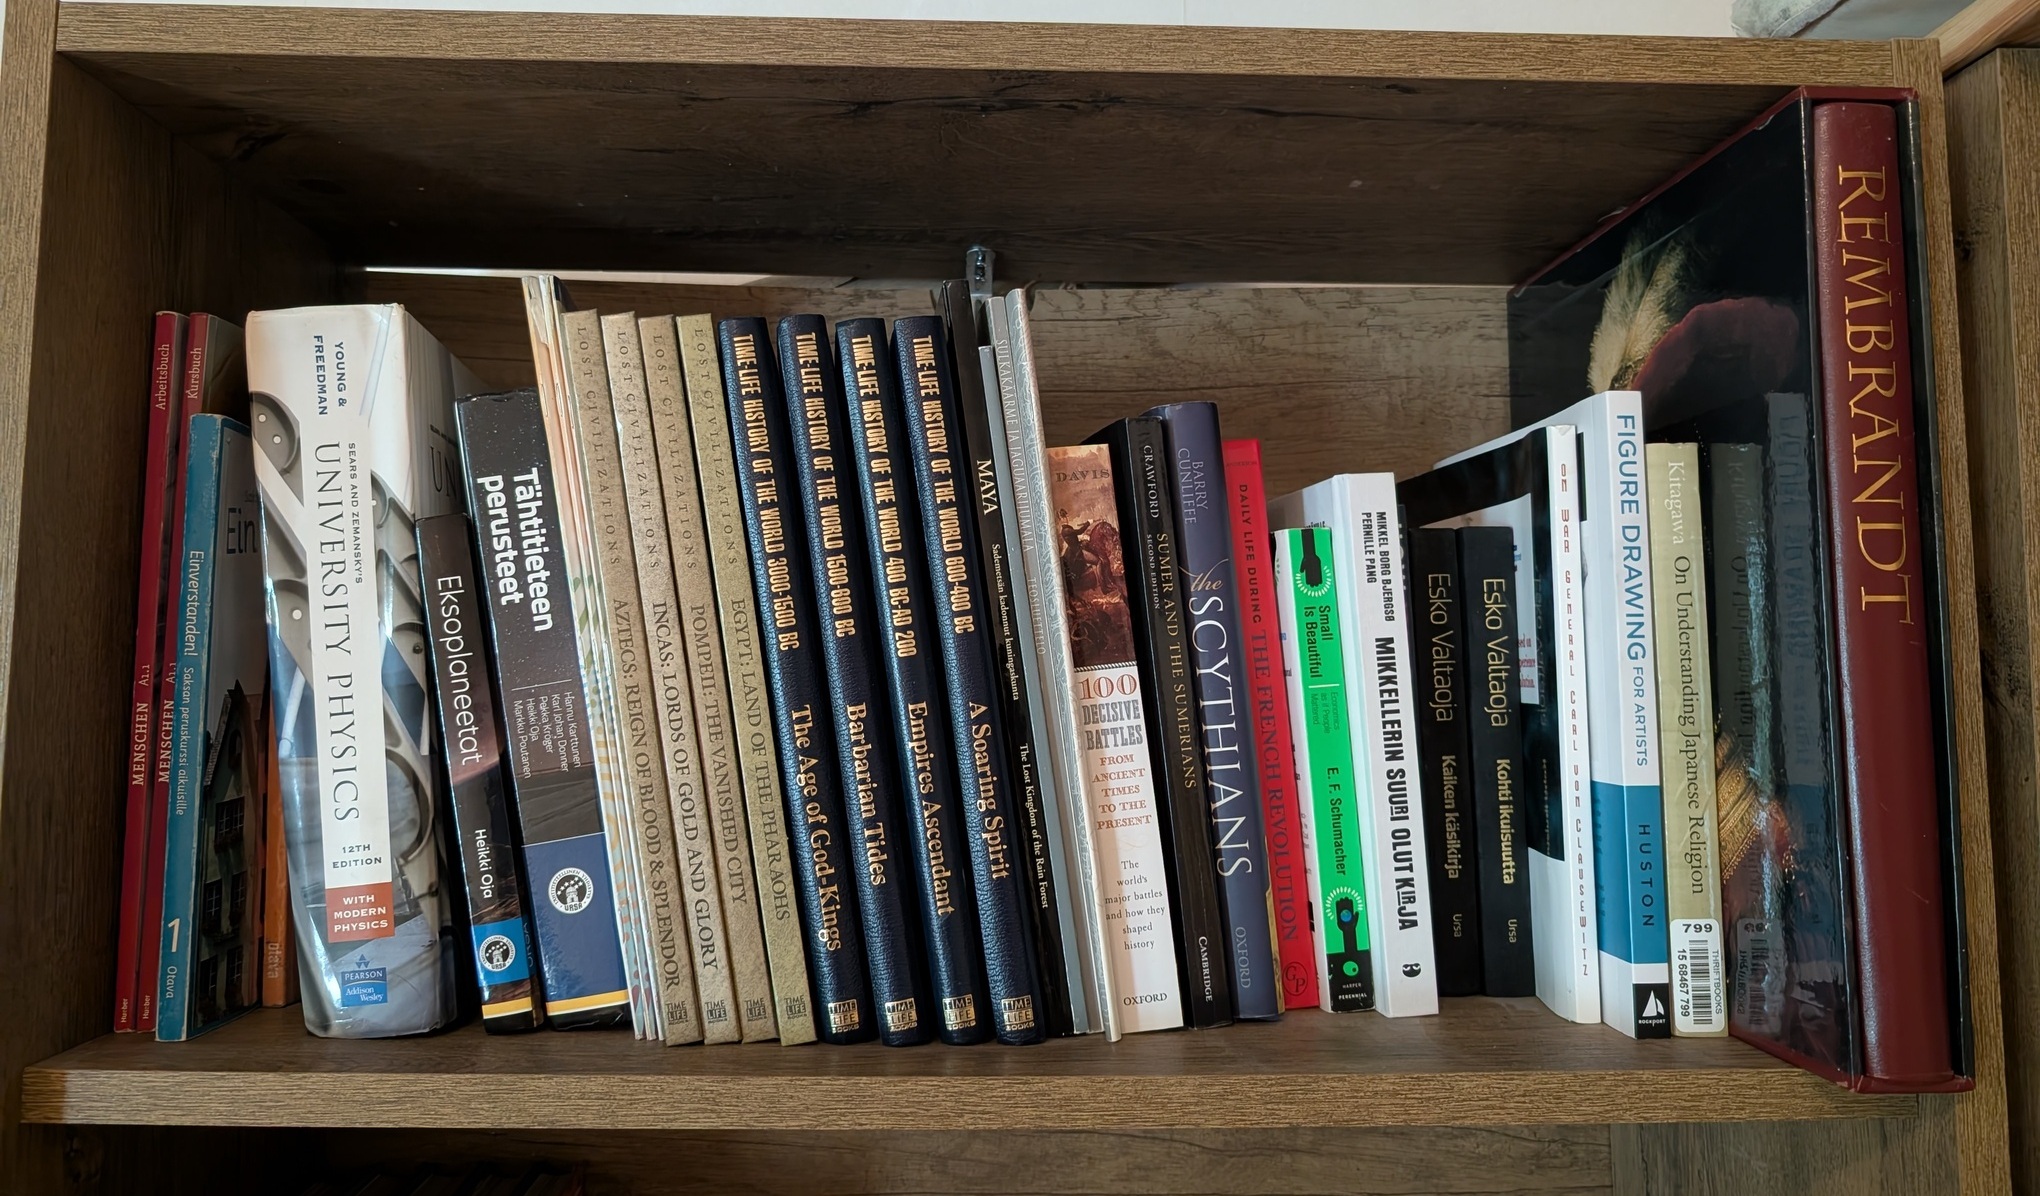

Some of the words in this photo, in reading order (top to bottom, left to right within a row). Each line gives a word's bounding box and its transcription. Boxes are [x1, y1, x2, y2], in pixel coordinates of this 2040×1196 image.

[155, 343, 170, 410] Arbeitsbuch
[186, 346, 201, 399] Kursbuch
[313, 335, 327, 414] FREEDMAN
[334, 341, 346, 392] YOUNG
[732, 334, 760, 395] TIME-LIFE
[338, 397, 346, 406] &
[1837, 164, 1906, 625] REMBRANDT
[694, 328, 710, 380] LOST
[703, 390, 737, 565] CIVILIZATIONS
[742, 399, 769, 452] HISTORY
[348, 442, 357, 479] SEARS
[751, 458, 773, 475] OF
[1056, 468, 1110, 483] DAVIS
[1143, 445, 1158, 517] CRAWFORD
[1616, 414, 1640, 515] FIGURE
[350, 484, 358, 507] AND
[754, 479, 778, 503] THE
[977, 459, 997, 515] MAYA
[1178, 447, 1196, 525] CUNLIFFE
[1192, 461, 1207, 510] BARRY
[1239, 484, 1250, 525] DAILY
[1664, 461, 1686, 544] Kitagawa
[314, 441, 351, 656] UNIVERSITY
[351, 511, 362, 583] ZEMANSKY'S
[477, 474, 523, 605] perusteet
[513, 466, 553, 631] Tähtitieteen
[759, 507, 785, 553] WORLD
[1244, 531, 1254, 561] LIFE
[1362, 512, 1375, 555] PERNILLE
[1376, 511, 1388, 548] MIKKEL
[1146, 534, 1154, 568] SECOND
[1150, 572, 1159, 608] EDITION
[1156, 533, 1173, 592] SUMER
[1365, 557, 1377, 583] PANG
[1378, 550, 1391, 576] BORG
[1674, 555, 1690, 584] On
[184, 550, 204, 655] Einverstanden!
[1247, 567, 1261, 624] DURING
[1303, 606, 1316, 617] Is
[1428, 573, 1452, 624] Esko
[1483, 578, 1506, 629] Esko
[1622, 525, 1646, 660] DRAWING
[652, 600, 674, 667] INCAS:
[730, 598, 752, 666] EGYPT:
[991, 543, 1004, 592] Sademetsän
[998, 594, 1010, 635] kadonnut
[1004, 637, 1018, 700] kuningaskunta
[1164, 599, 1178, 635] AND
[1317, 604, 1333, 640] Small
[778, 632, 800, 650] BC
[1169, 642, 1183, 677] THE
[1251, 628, 1270, 679] THE
[1304, 620, 1323, 678] Beautiful
[1676, 591, 1698, 726] Understanding
[182, 667, 194, 703] Saksan
[437, 574, 483, 765] Eksoplaneetat
[1078, 673, 1138, 701] 100
[1428, 630, 1457, 721] Valtaoja
[1483, 635, 1511, 726] Valtaoja
[1632, 666, 1644, 697] FOR
[564, 691, 574, 720] Hannu
[662, 672, 685, 742] LORDS
[741, 672, 762, 727] LAND
[969, 702, 988, 719] A
[1082, 699, 1141, 726] DECISIVE
[1374, 636, 1403, 762] MIKKELLERIN
[132, 702, 148, 785] MENSCHEN
[158, 699, 174, 782] MENSCHEN
[177, 706, 190, 766] peruskurssi
[327, 672, 359, 821] PHYSICS
[568, 722, 585, 767] Karttunen
[750, 732, 766, 756] OF
[790, 704, 811, 749] The
[1085, 724, 1144, 751] BATTLES
[1173, 684, 1196, 787] SUMERIANS
[1189, 595, 1252, 878] SCYTHIANS
[1256, 684, 1281, 780] FRENCH
[1634, 703, 1647, 766] ARTISTS
[673, 748, 690, 774] OF
[972, 724, 997, 812] Soaring
[1019, 742, 1029, 761] The
[1022, 763, 1030, 782] Lost
[1099, 754, 1135, 767] FROM
[1326, 767, 1339, 780] E.
[1680, 731, 1700, 808] Japanese
[174, 769, 188, 814] aikuisille
[755, 760, 773, 805] THE
[795, 754, 818, 796] Age
[846, 702, 877, 818] Barbarian
[864, 822, 887, 885] Tides
[1092, 768, 1146, 783] ANCIENT
[1101, 784, 1141, 798] TIMES
[1328, 783, 1341, 793] F.
[1385, 768, 1409, 822] SUURI
[1441, 755, 1457, 808] Kaiken
[1496, 759, 1512, 800] Kohti
[678, 782, 698, 840] GOLD
[804, 801, 827, 823] of
[908, 702, 934, 793] Empires
[922, 800, 955, 915] Ascendant
[1024, 785, 1037, 826] Kingdom
[1096, 814, 1152, 831] PRESENT
[1098, 804, 1116, 814] TO
[1119, 800, 1147, 811] THE
[342, 843, 371, 854] 12TH
[474, 828, 491, 870] Heikki
[985, 816, 1007, 879] Spirit
[1031, 829, 1041, 839] of
[1033, 840, 1042, 854] the
[1328, 797, 1348, 875] Schumacher
[1391, 827, 1413, 872] OLUT
[1444, 812, 1461, 878] käsikirja
[1499, 804, 1515, 884] ikuisuutta
[1684, 815, 1706, 894] Religion
[332, 856, 382, 869] EDITION
[686, 848, 705, 892] AND
[760, 808, 789, 920] PHARAOHS
[1035, 857, 1045, 878] Rain
[1116, 875, 1148, 887] world's
[1120, 860, 1139, 870] The
[1267, 786, 1297, 941] REVOLUTION
[1638, 824, 1654, 926] HUSTON
[342, 894, 375, 905] WITH
[479, 874, 494, 898] Oja
[810, 828, 842, 951] God-Kings
[1038, 881, 1048, 908] Forest
[1104, 892, 1132, 906] major
[1134, 888, 1163, 901] battles
[1394, 877, 1420, 930] KIRJA
[168, 918, 179, 952] 1
[333, 906, 386, 920] MODERN
[334, 919, 389, 933] PHYSICS
[694, 898, 718, 969] GLORY
[1105, 910, 1123, 920] and
[1125, 908, 1144, 918] how
[1146, 905, 1166, 916] they
[1122, 922, 1153, 936] shaped
[1507, 918, 1517, 942] Ursa
[1682, 923, 1713, 934] 799
[1124, 938, 1155, 951] history
[1678, 948, 1687, 961] 15
[165, 965, 177, 998] Otava
[344, 970, 383, 981] PEARSON
[1198, 936, 1212, 1001] CAMBRIDGE
[1678, 963, 1689, 996] 68467
[1712, 948, 1722, 1014] THRIFTBOOKS
[1123, 992, 1168, 1006] OXFORD
[1680, 997, 1690, 1017] 799
